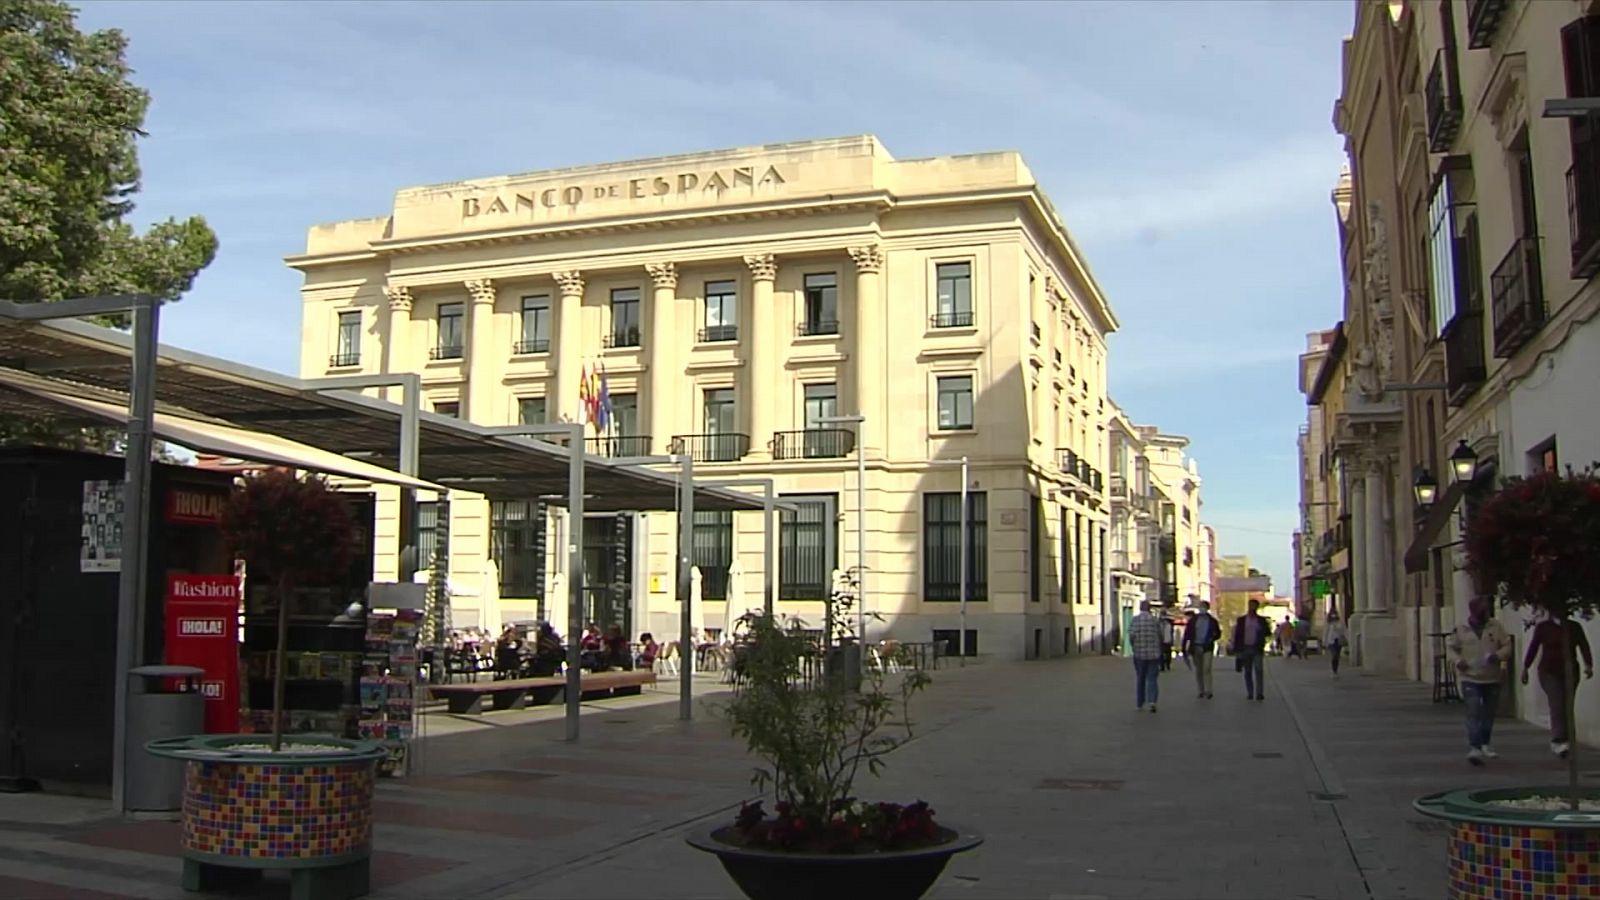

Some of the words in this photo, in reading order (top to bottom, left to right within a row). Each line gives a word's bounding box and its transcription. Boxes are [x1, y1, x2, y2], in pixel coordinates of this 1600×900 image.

[462, 185, 584, 218] BANCO
[594, 184, 619, 199] DE
[629, 164, 786, 200] ESPAÑA
[181, 620, 221, 634] ¡HOLA!
